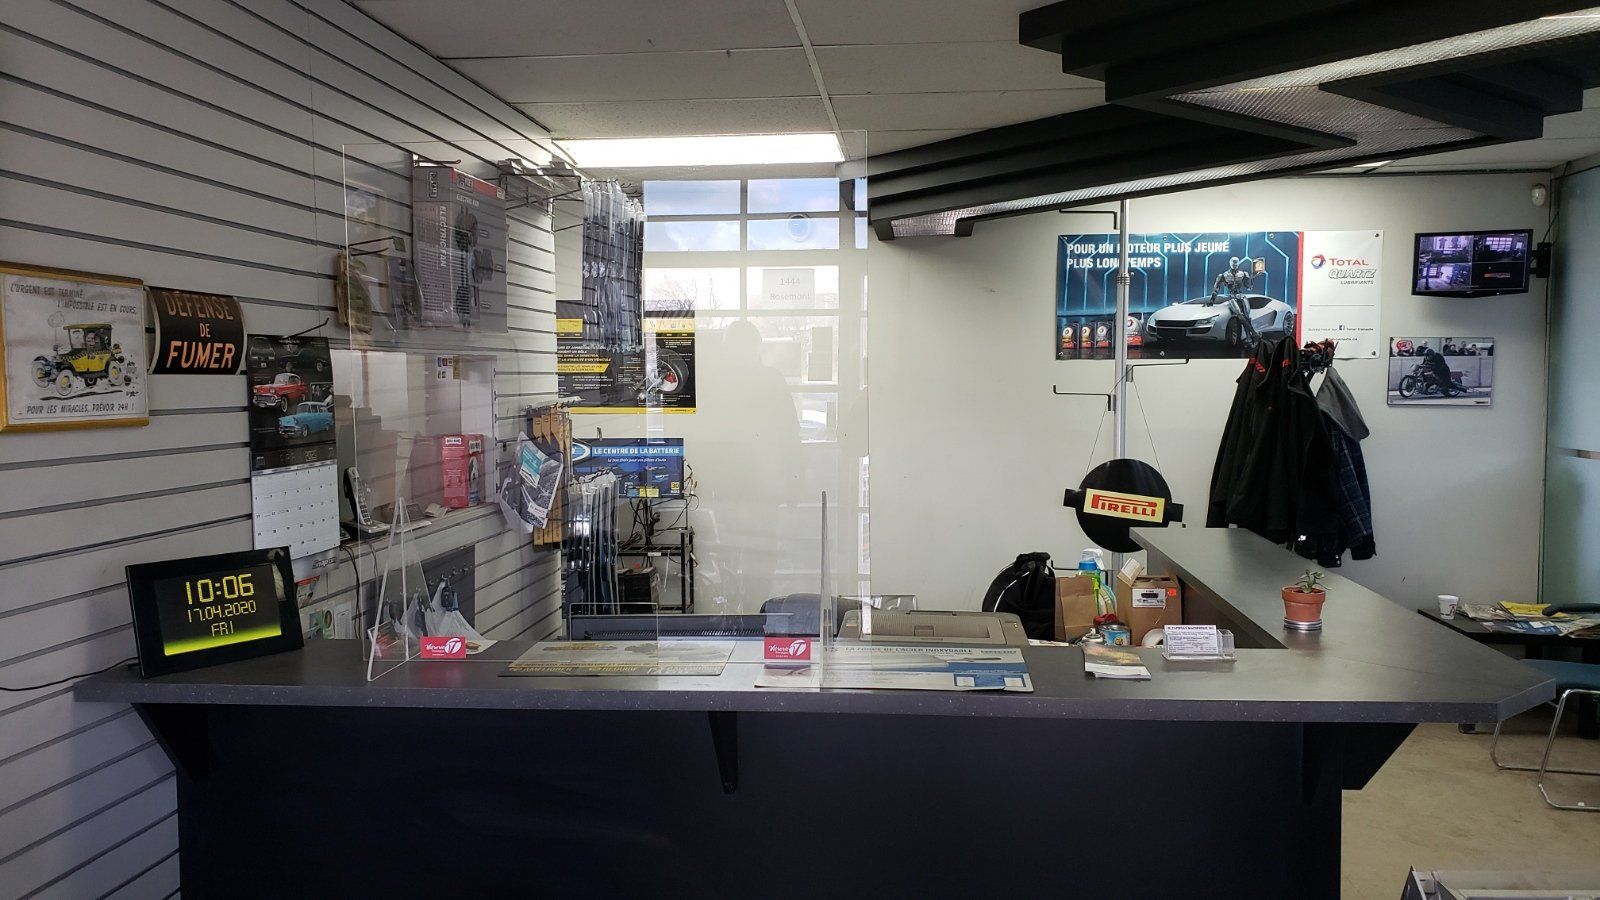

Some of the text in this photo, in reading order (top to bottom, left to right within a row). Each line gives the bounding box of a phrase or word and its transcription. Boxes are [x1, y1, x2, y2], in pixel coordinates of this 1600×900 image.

[439, 205, 447, 248] ELECTRIC
[1067, 243, 1096, 255] POUR
[1098, 243, 1114, 254] UN
[1163, 242, 1192, 254] PLUS
[1194, 241, 1229, 253] JEUNE
[1067, 257, 1162, 269] PLUS LONEMPS
[1329, 258, 1369, 266] TOTAL
[1328, 268, 1377, 279] QUARTZ
[769, 292, 810, 301] Rosemont
[200, 323, 211, 337] DE
[166, 340, 236, 369] FUMER
[46, 404, 58, 414] LES
[594, 447, 681, 455] LE CENTRE DE LA BATTERIE
[1090, 493, 1158, 517] PIRELLI
[185, 573, 255, 605] 10:06
[186, 600, 257, 623] 17.04.2020
[210, 620, 234, 637] FRI
